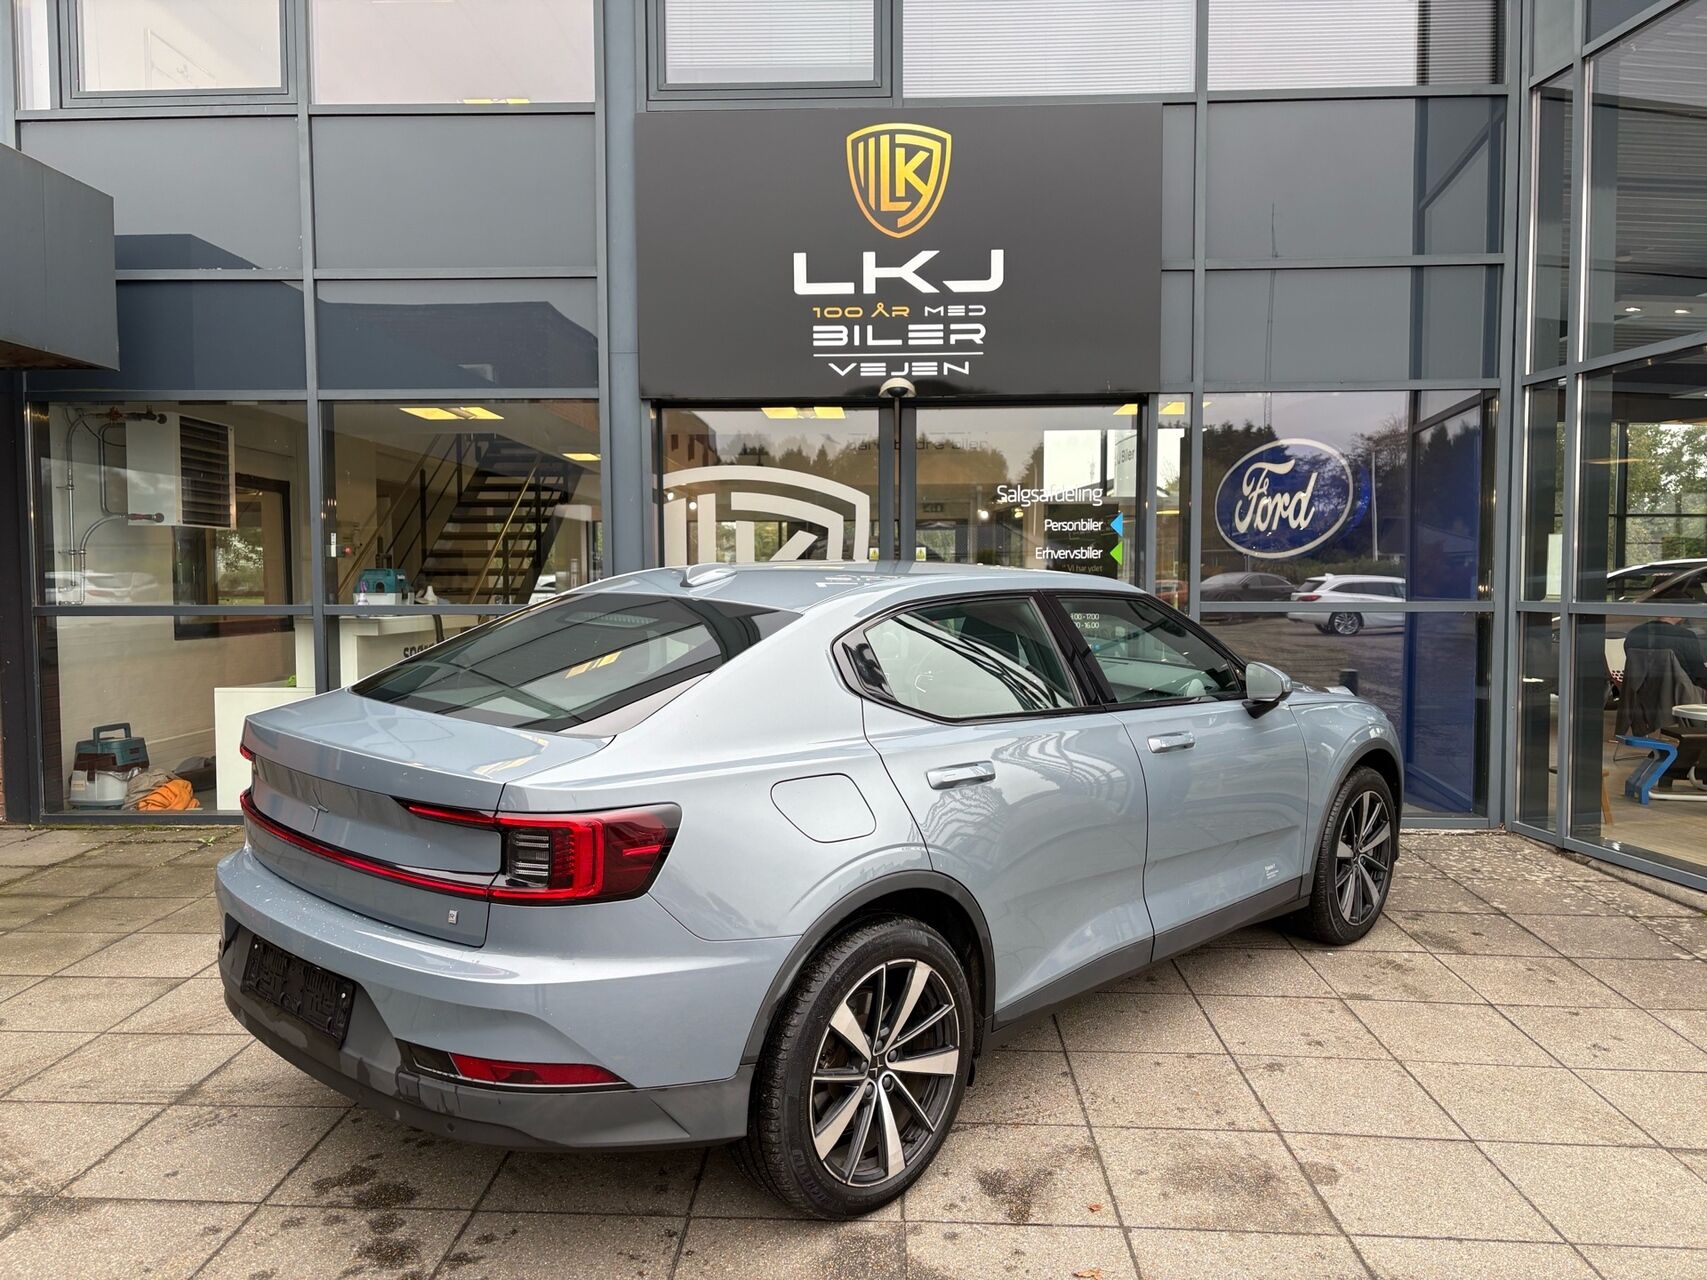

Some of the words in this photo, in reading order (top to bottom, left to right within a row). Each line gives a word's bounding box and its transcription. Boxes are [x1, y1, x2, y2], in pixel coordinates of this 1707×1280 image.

[793, 249, 1004, 295] LKJ
[812, 306, 864, 318] 100
[871, 302, 910, 317] ÅR
[924, 305, 986, 316] MED
[812, 323, 986, 346] BILER
[828, 361, 969, 376] VEJEN
[996, 484, 1104, 507] Salgsafdeling
[1234, 458, 1318, 534] Ford
[1044, 518, 1104, 532] Personbiler
[1035, 546, 1104, 560] Erhvervsbiler
